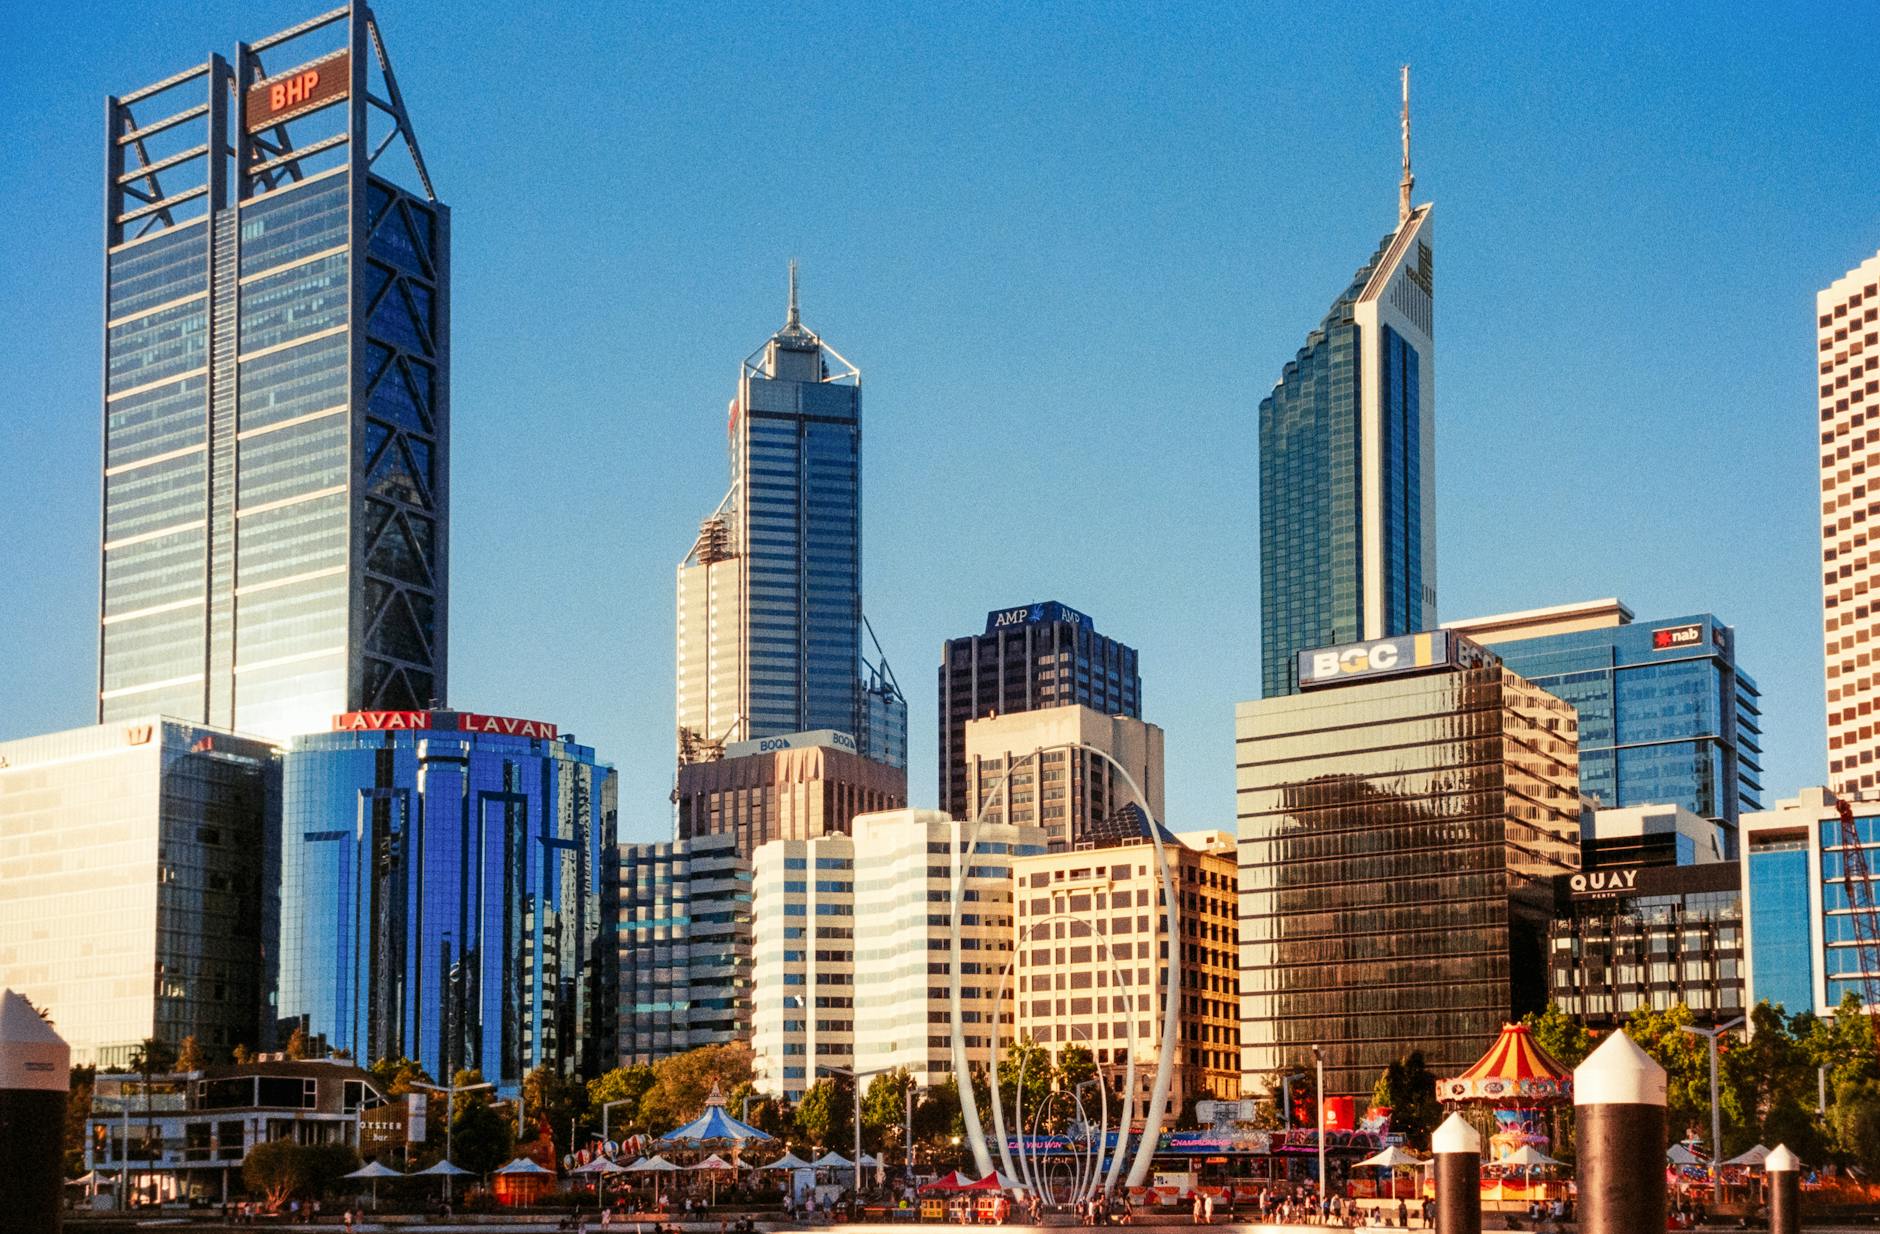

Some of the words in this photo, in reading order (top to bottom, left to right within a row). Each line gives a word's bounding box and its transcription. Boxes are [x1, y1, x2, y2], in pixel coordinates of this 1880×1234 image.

[271, 71, 319, 111] BHP
[995, 609, 1028, 627] AMP
[1061, 607, 1080, 623] AMP
[1672, 628, 1699, 642] nab
[1313, 644, 1398, 679] BGC
[335, 712, 426, 730] LAVAN
[465, 715, 554, 739] LAVAN
[760, 740, 784, 752] BOQ
[833, 732, 850, 747] BOQ
[1570, 870, 1638, 892] QUAY
[360, 1121, 402, 1130] OYSTER
